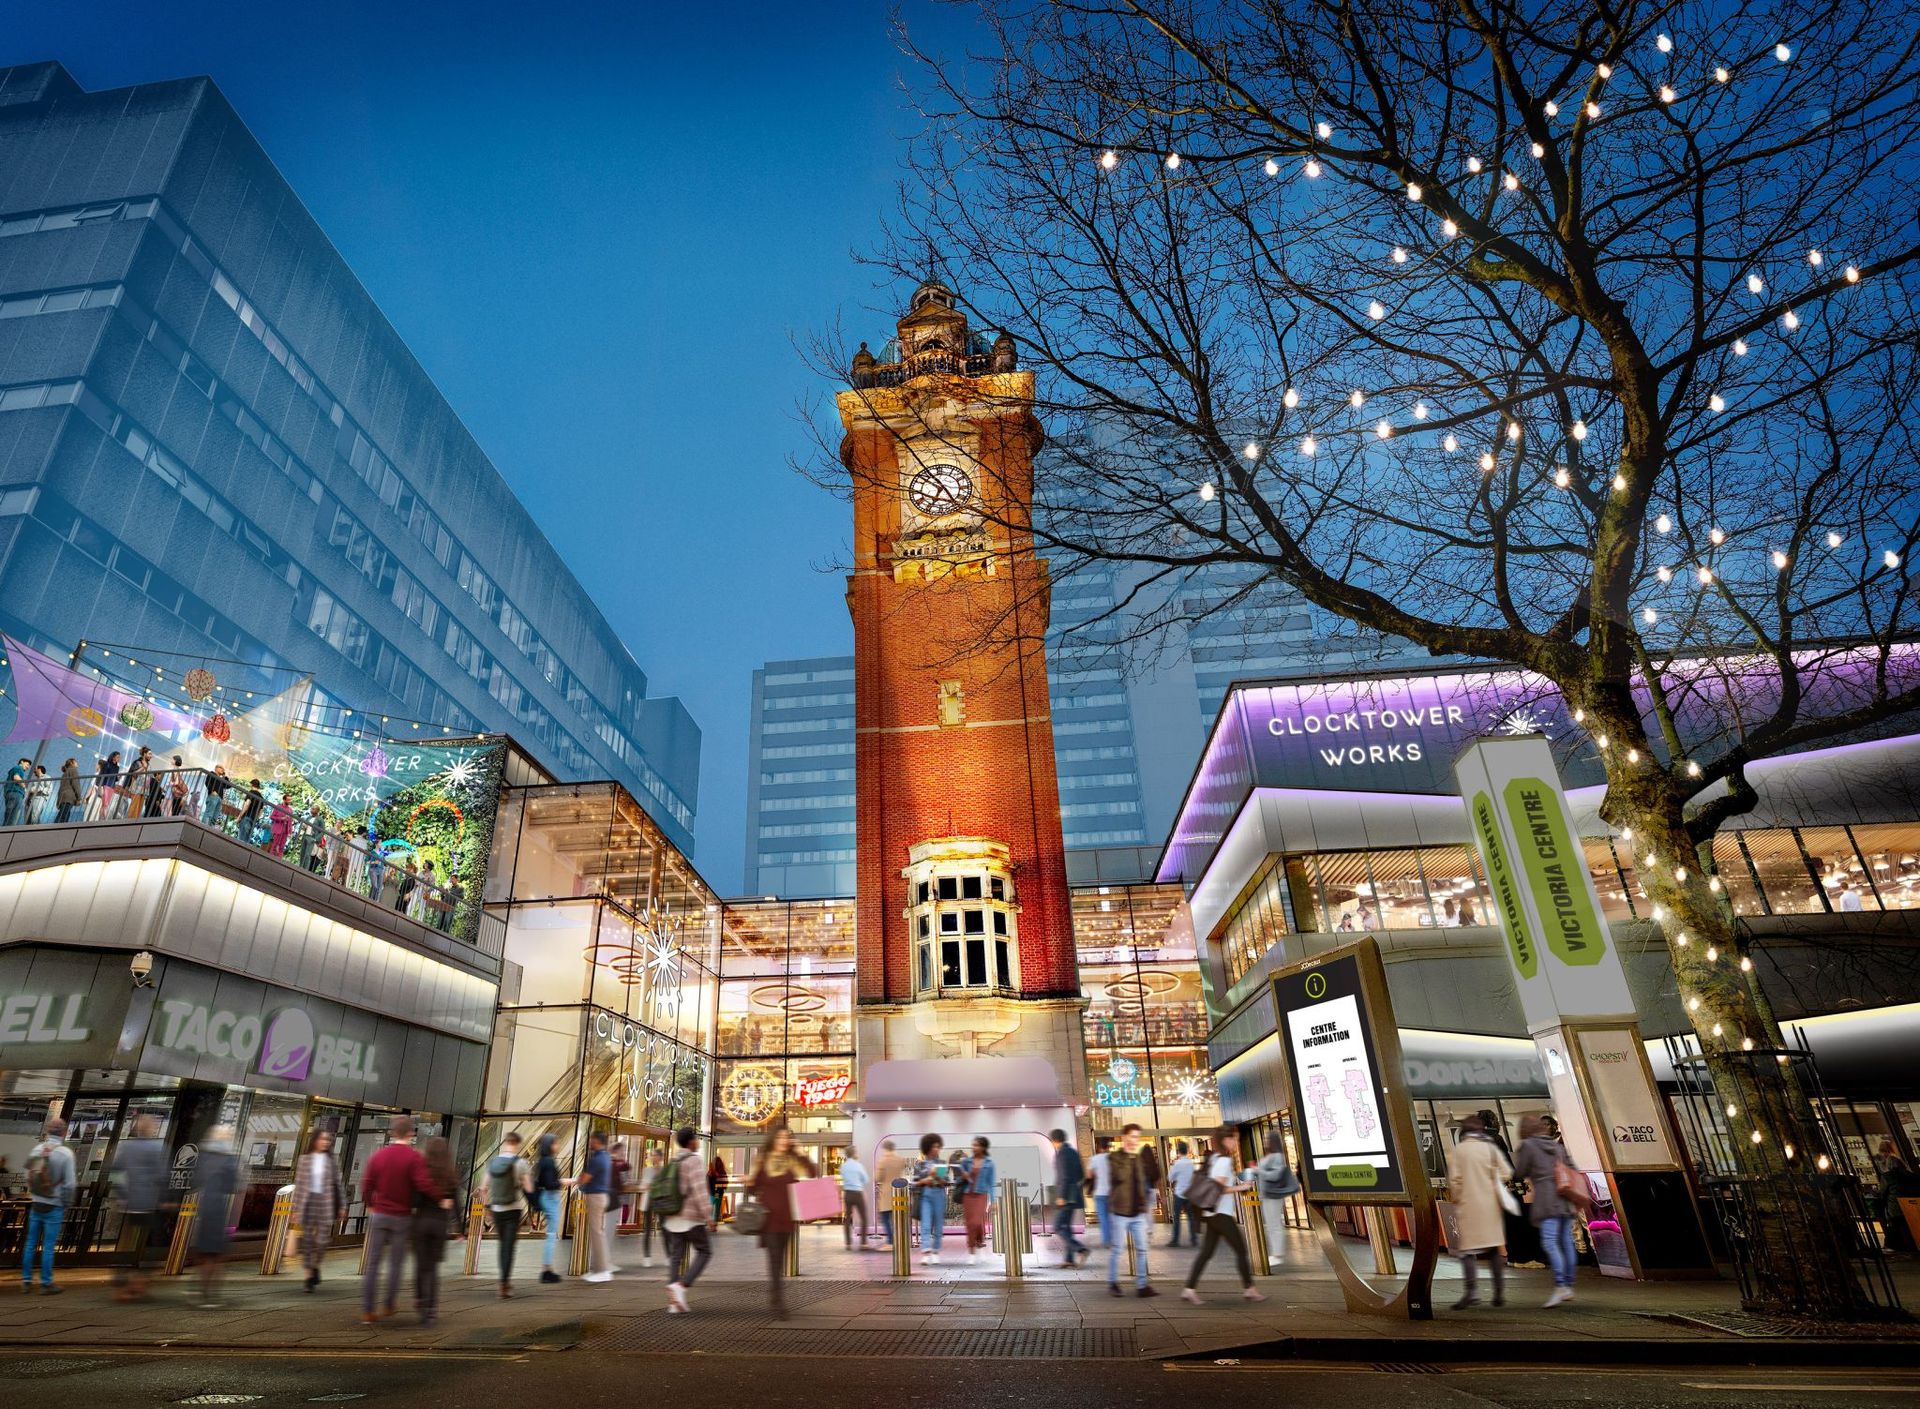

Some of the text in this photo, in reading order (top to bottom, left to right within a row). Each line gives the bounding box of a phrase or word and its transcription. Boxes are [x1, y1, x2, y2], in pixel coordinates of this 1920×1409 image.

[1268, 705, 1465, 736] CLOCKTOWER
[1319, 743, 1422, 767] WORKS
[300, 786, 377, 805] WORKS
[1520, 789, 1588, 953] VICTORIA CENTRE
[1478, 803, 1530, 965] VICTORIA CENTRE
[0, 993, 89, 1042] ELL
[1310, 1021, 1337, 1036] CENTRE
[163, 1000, 378, 1083] TACO BELL
[596, 1012, 708, 1077] CLOCKTOWER
[1302, 1030, 1350, 1049] INFORMATION
[627, 1073, 684, 1109] WORKS
[794, 1076, 850, 1100] FUEGO
[1097, 1083, 1151, 1105] Baity
[1628, 1126, 1654, 1134] TACO
[1632, 1134, 1657, 1143] BELL
[168, 1179, 192, 1190] BELL
